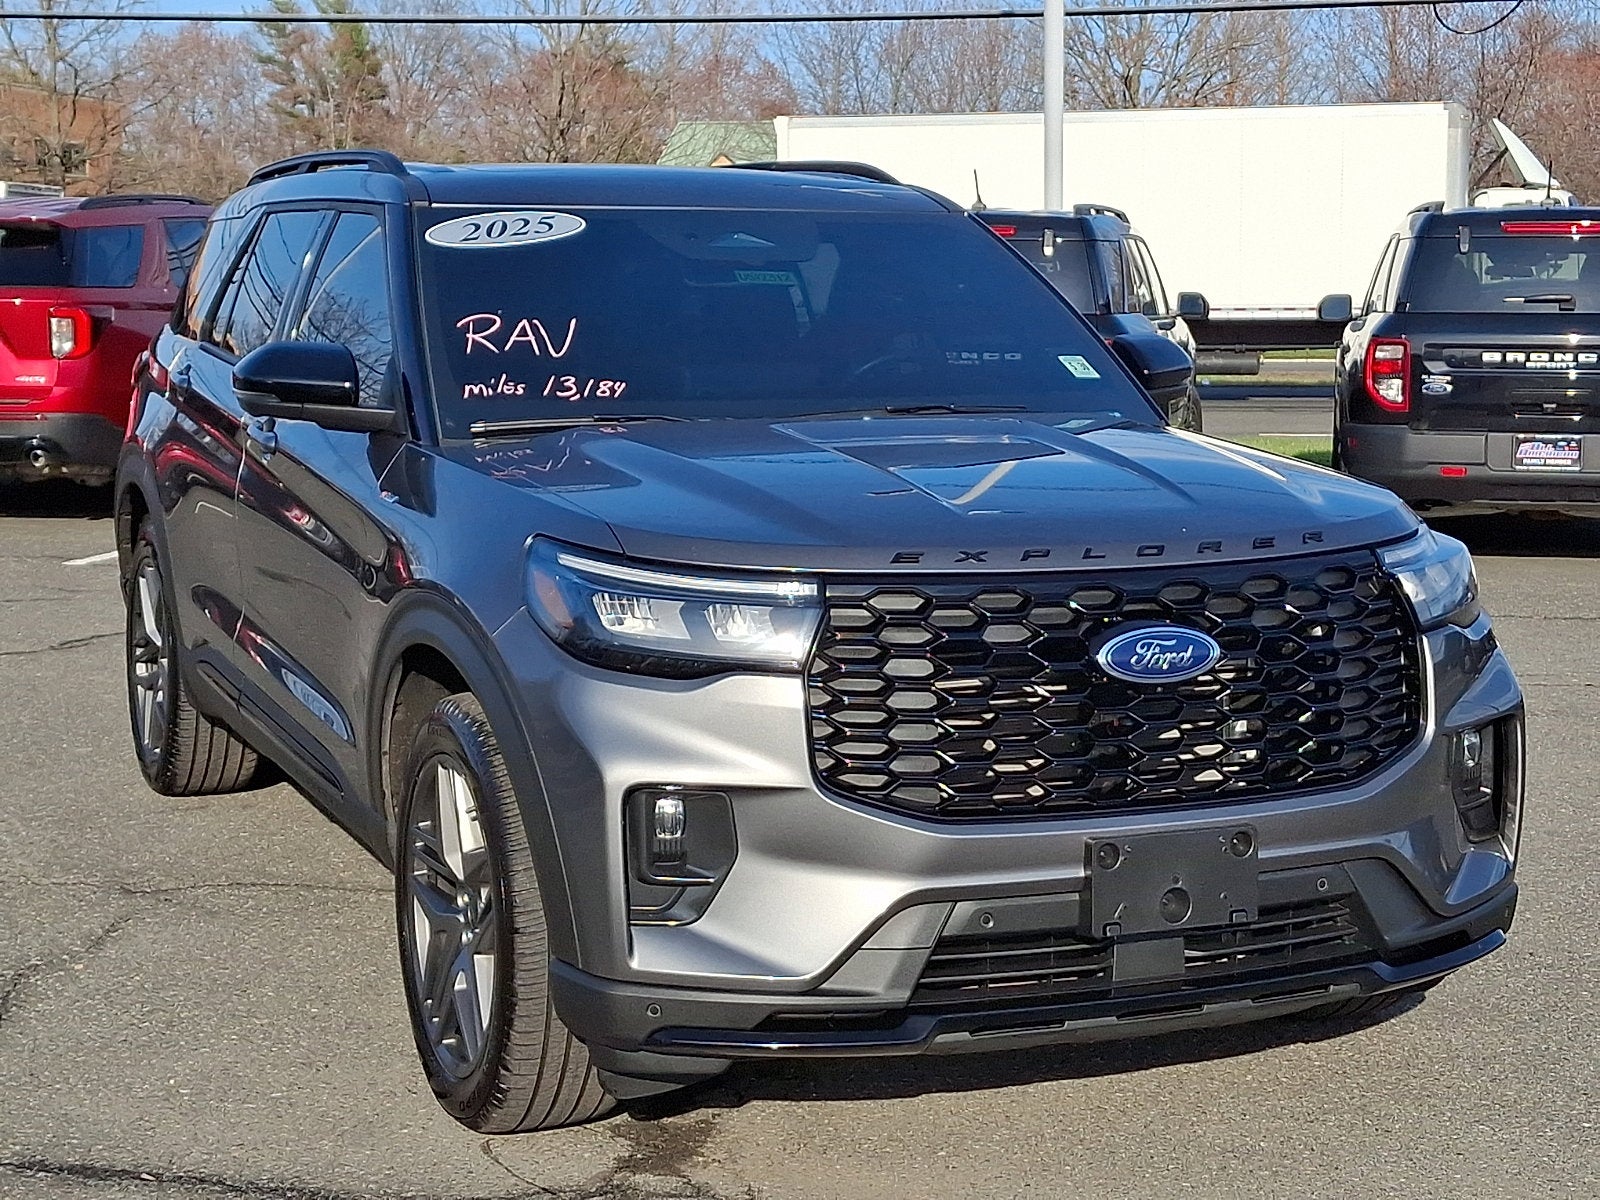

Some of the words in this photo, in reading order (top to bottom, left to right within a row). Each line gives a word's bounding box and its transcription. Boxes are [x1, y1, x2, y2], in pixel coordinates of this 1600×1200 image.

[460, 215, 556, 242] 2025
[456, 313, 577, 358] RAV
[463, 373, 526, 399] miles
[543, 375, 627, 401] 13,184
[890, 530, 1325, 565] EXPLORER
[1130, 639, 1194, 670] Ford
